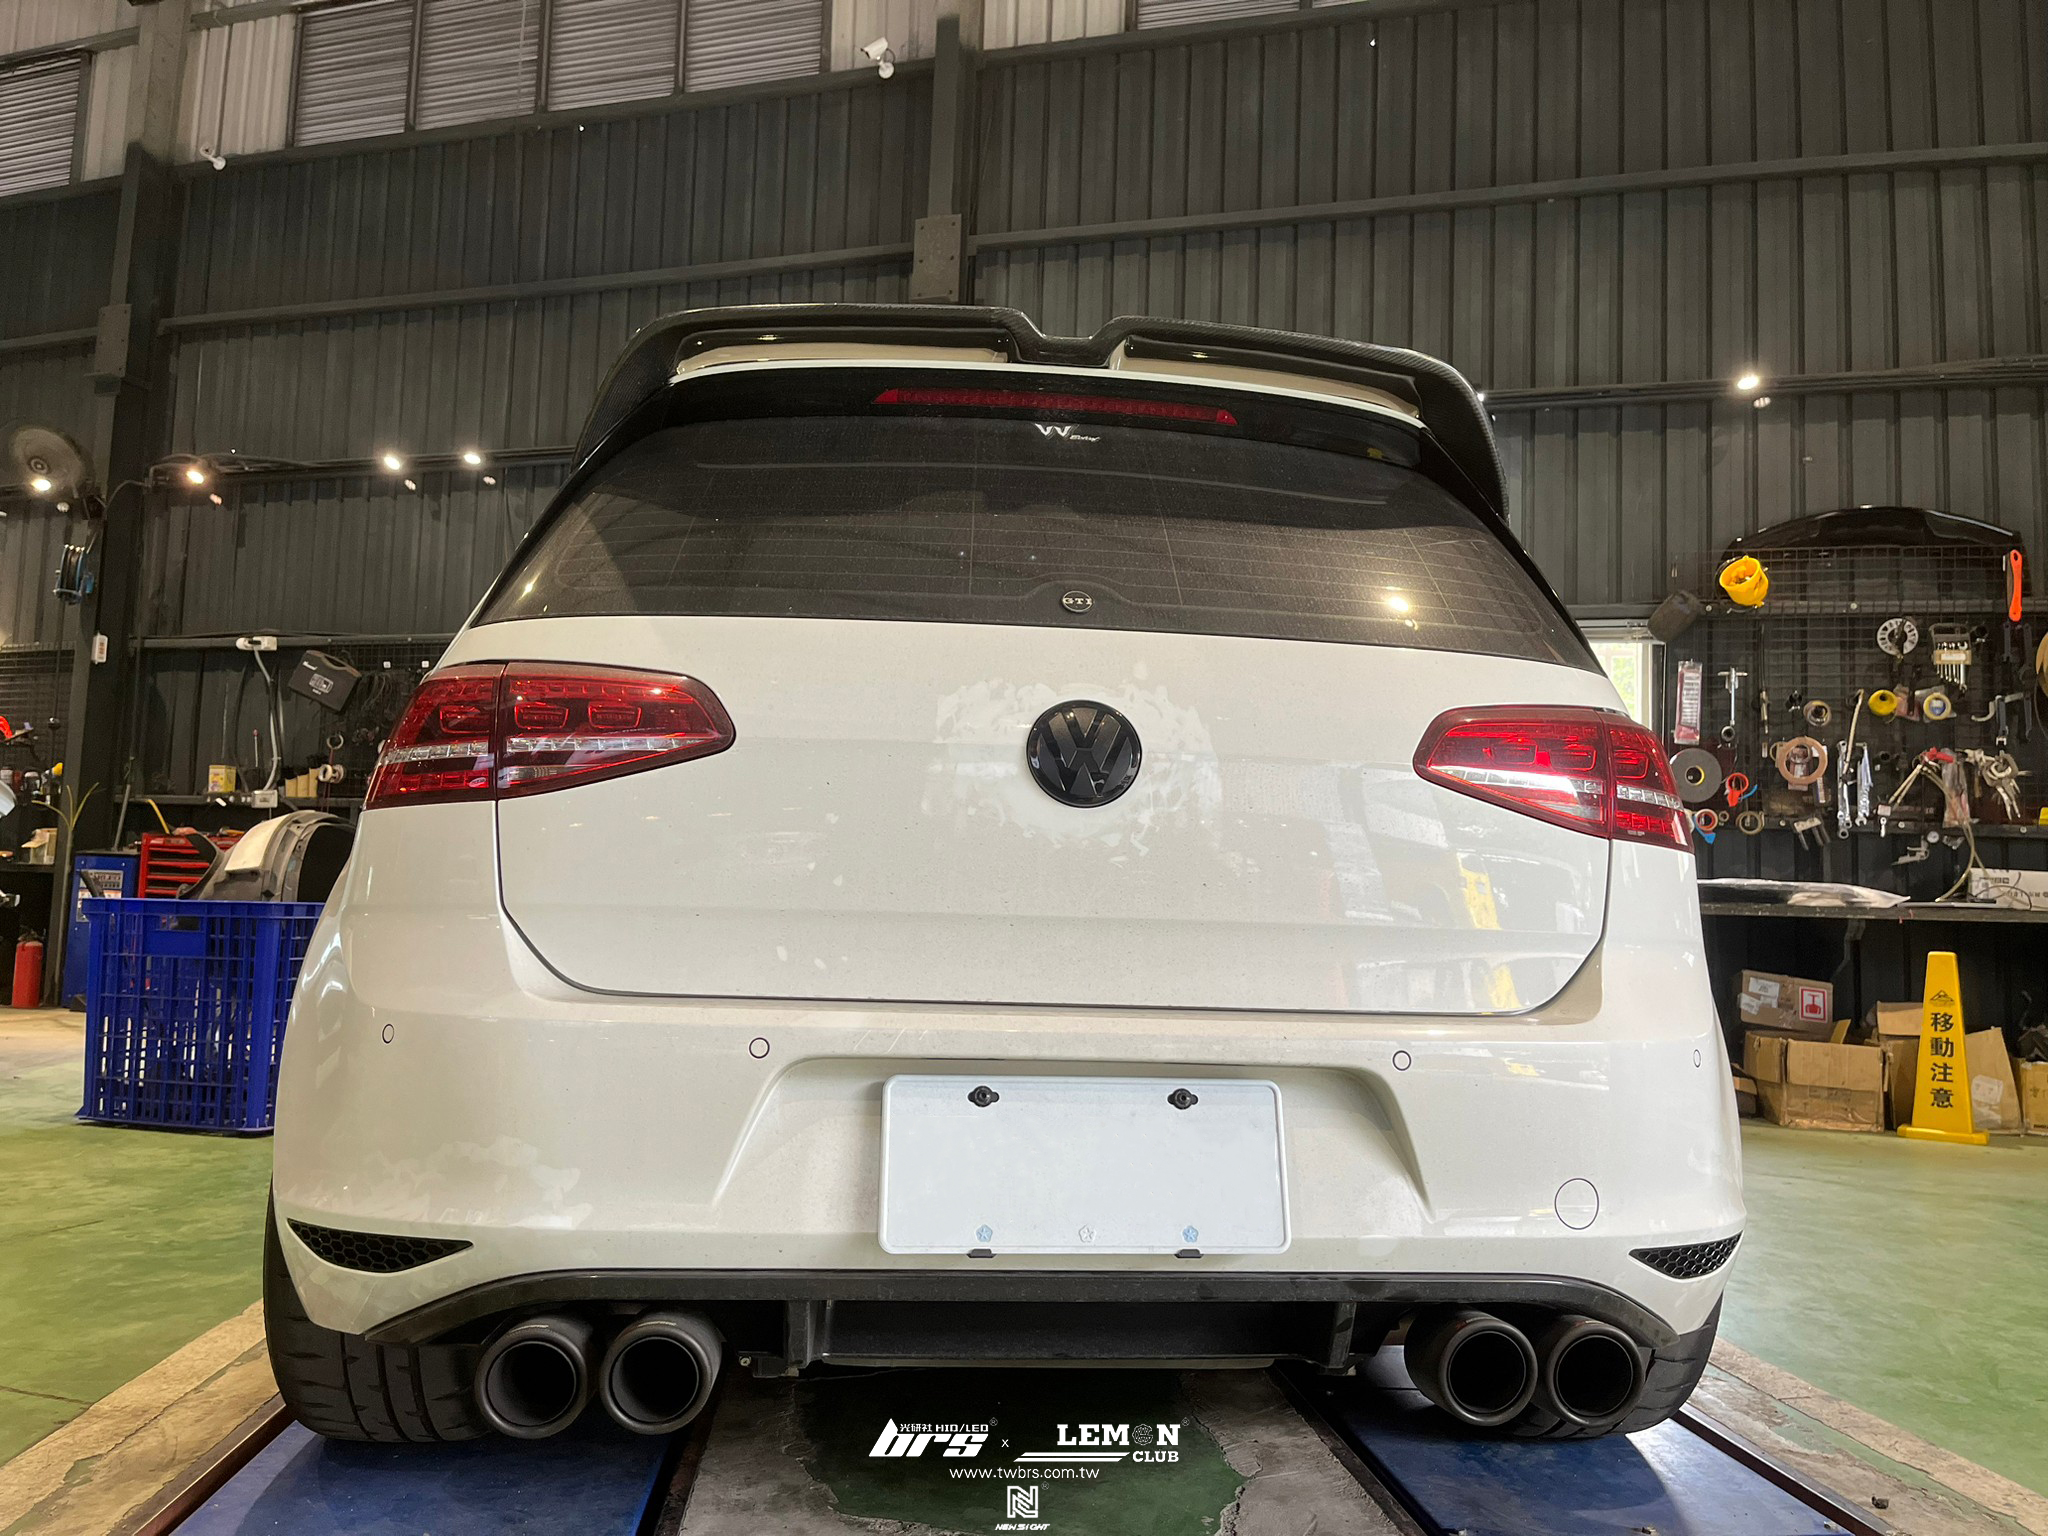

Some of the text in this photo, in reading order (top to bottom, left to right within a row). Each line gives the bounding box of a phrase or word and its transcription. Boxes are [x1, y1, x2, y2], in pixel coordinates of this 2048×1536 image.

[1062, 597, 1093, 605] GTI
[1929, 1011, 1955, 1109] 移動注意
